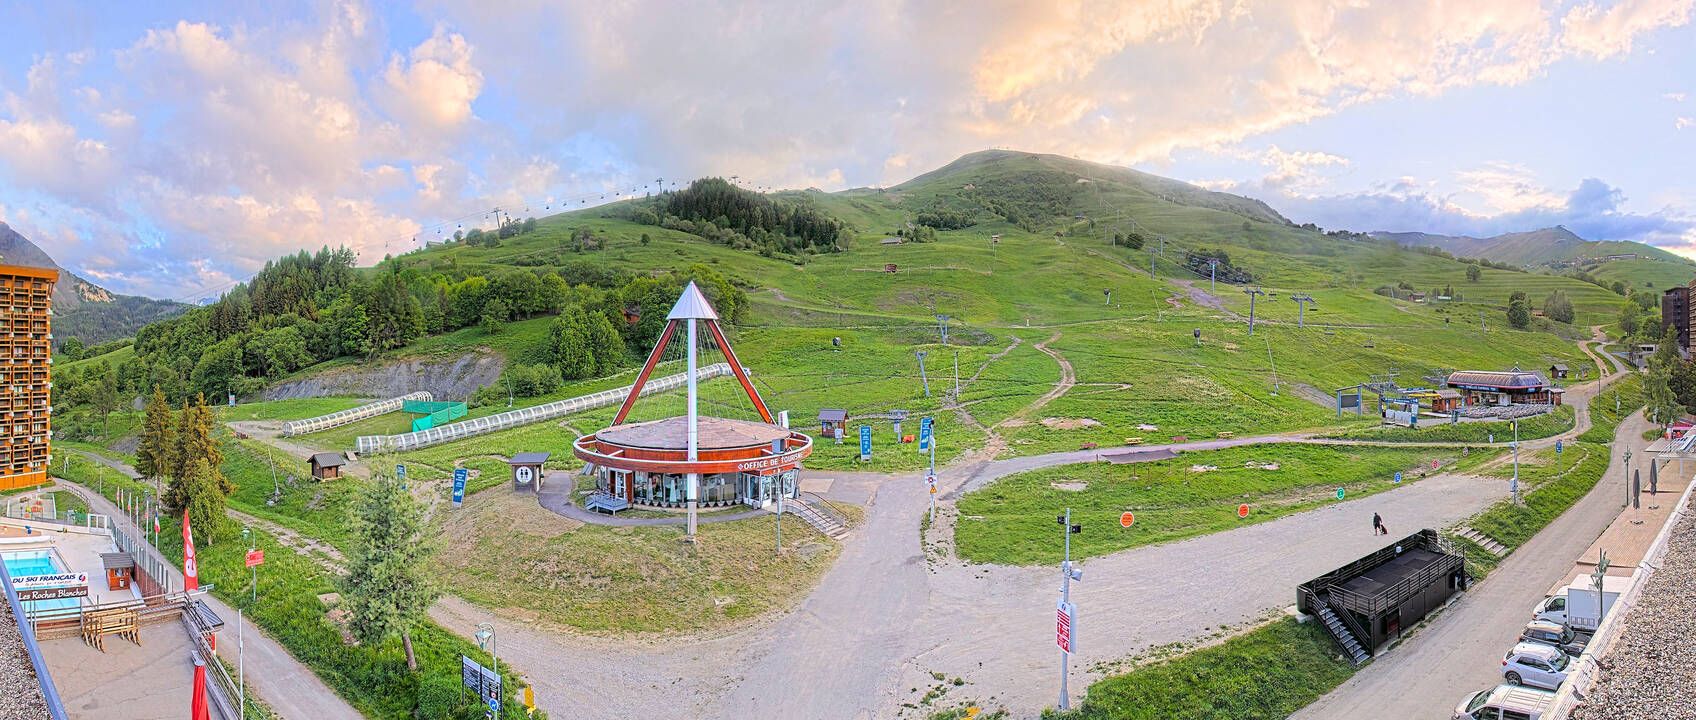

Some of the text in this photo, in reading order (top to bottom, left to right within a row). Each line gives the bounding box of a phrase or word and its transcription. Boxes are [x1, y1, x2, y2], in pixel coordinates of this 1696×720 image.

[744, 460, 768, 469] OFFICE
[32, 590, 56, 599] Roches
[58, 588, 87, 598] Blanches
